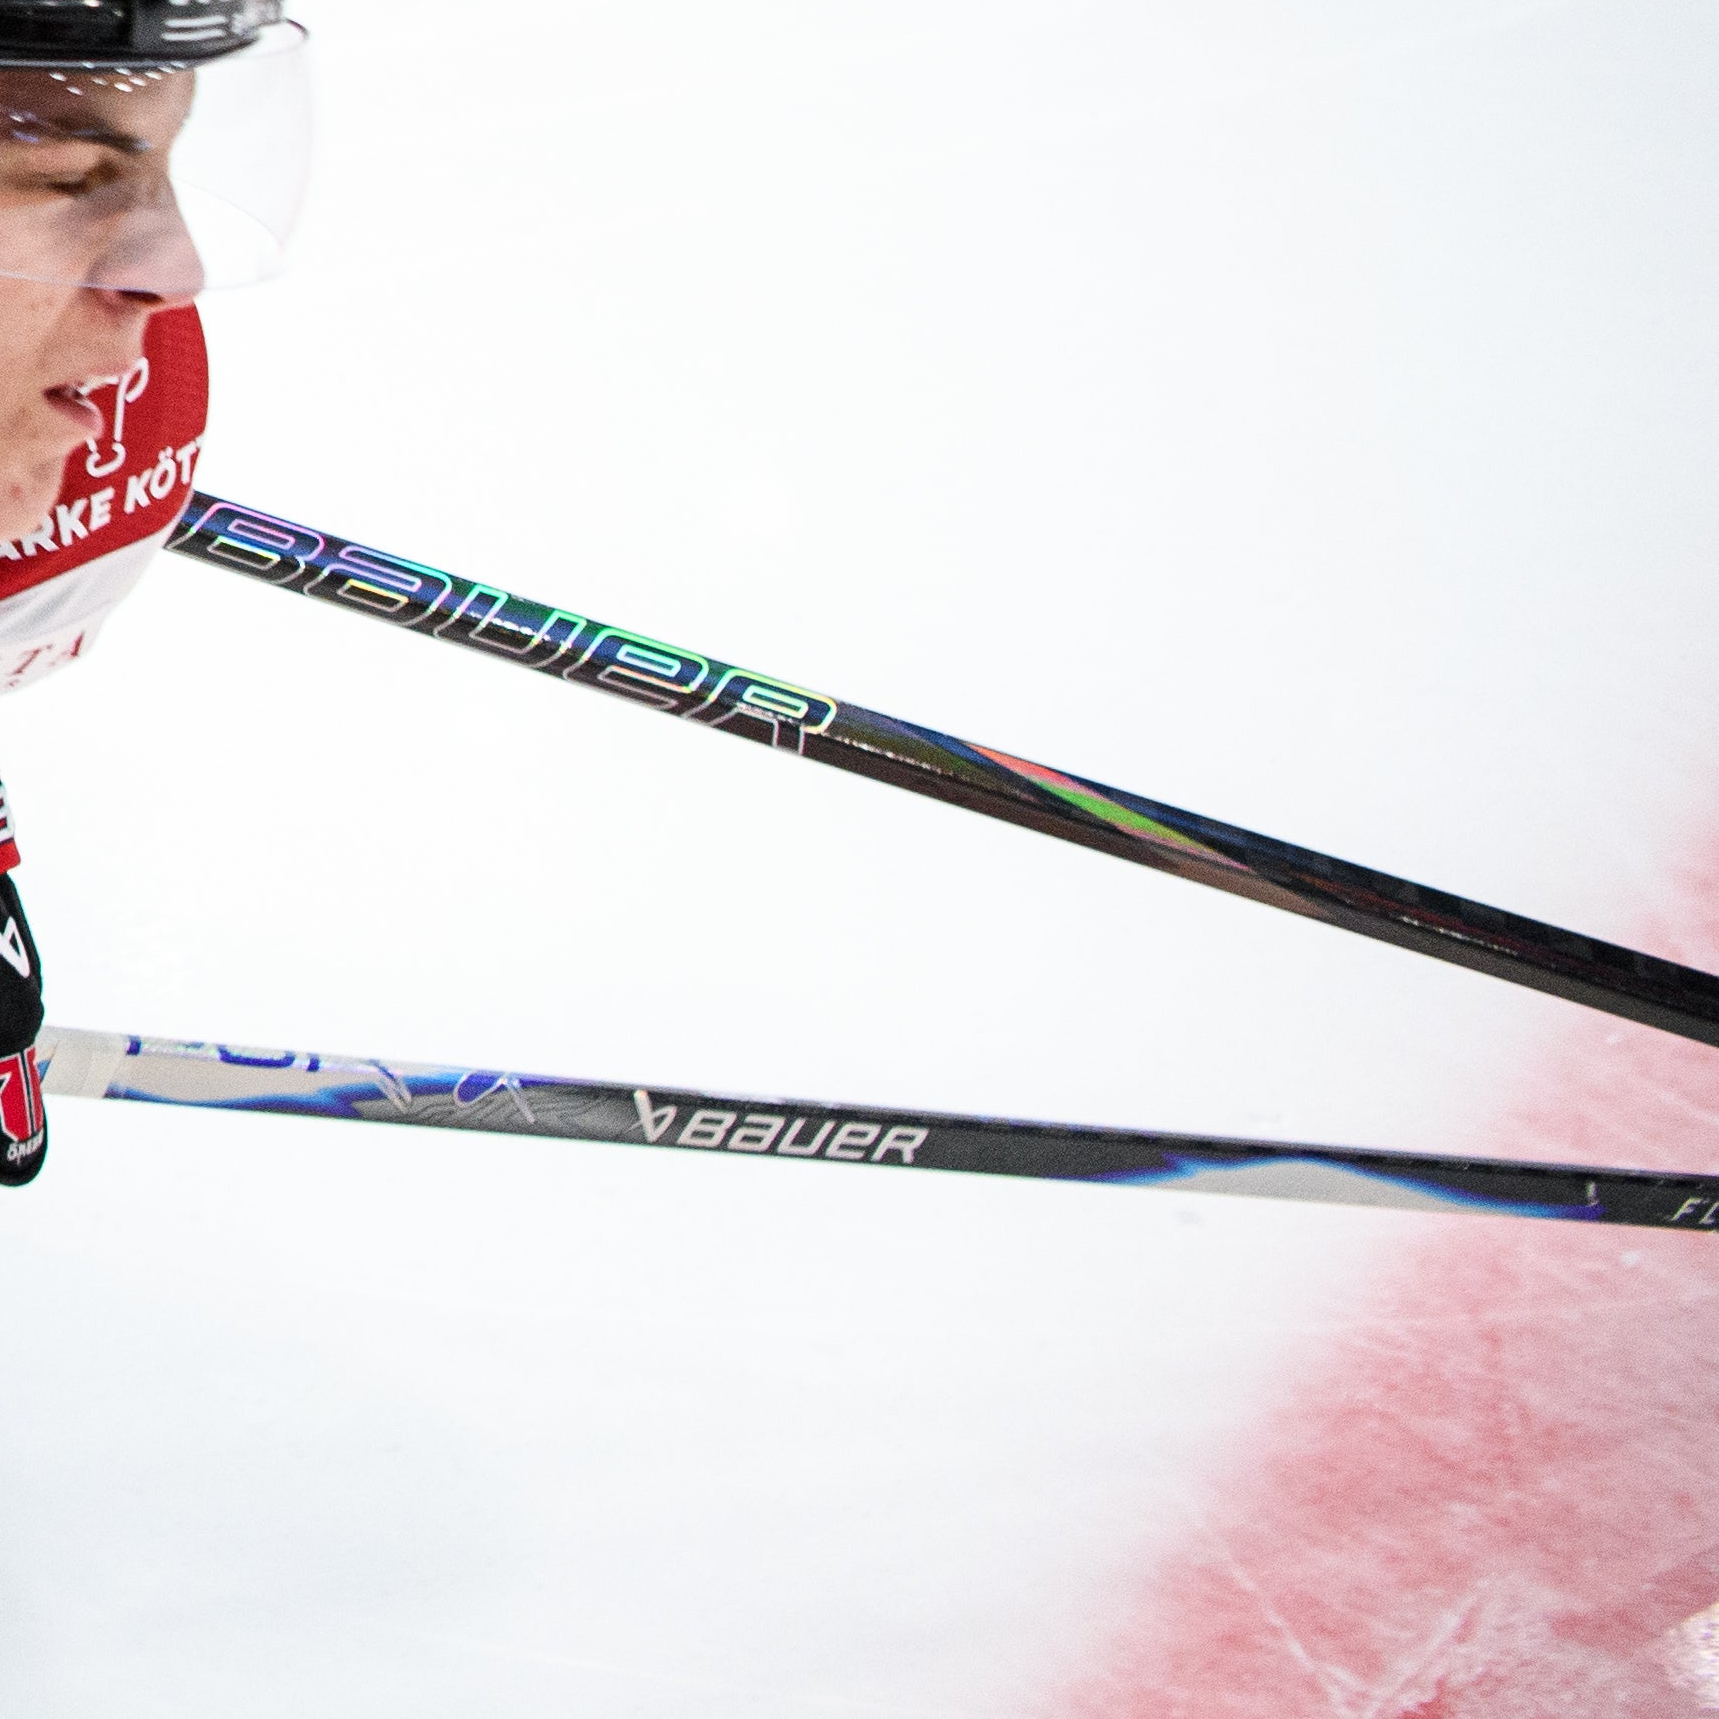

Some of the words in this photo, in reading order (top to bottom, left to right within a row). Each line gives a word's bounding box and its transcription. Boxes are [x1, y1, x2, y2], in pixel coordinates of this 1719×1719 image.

[123, 435, 206, 521] KÖT
[166, 500, 837, 757] BAUER
[675, 1115, 929, 1165] BAUER
